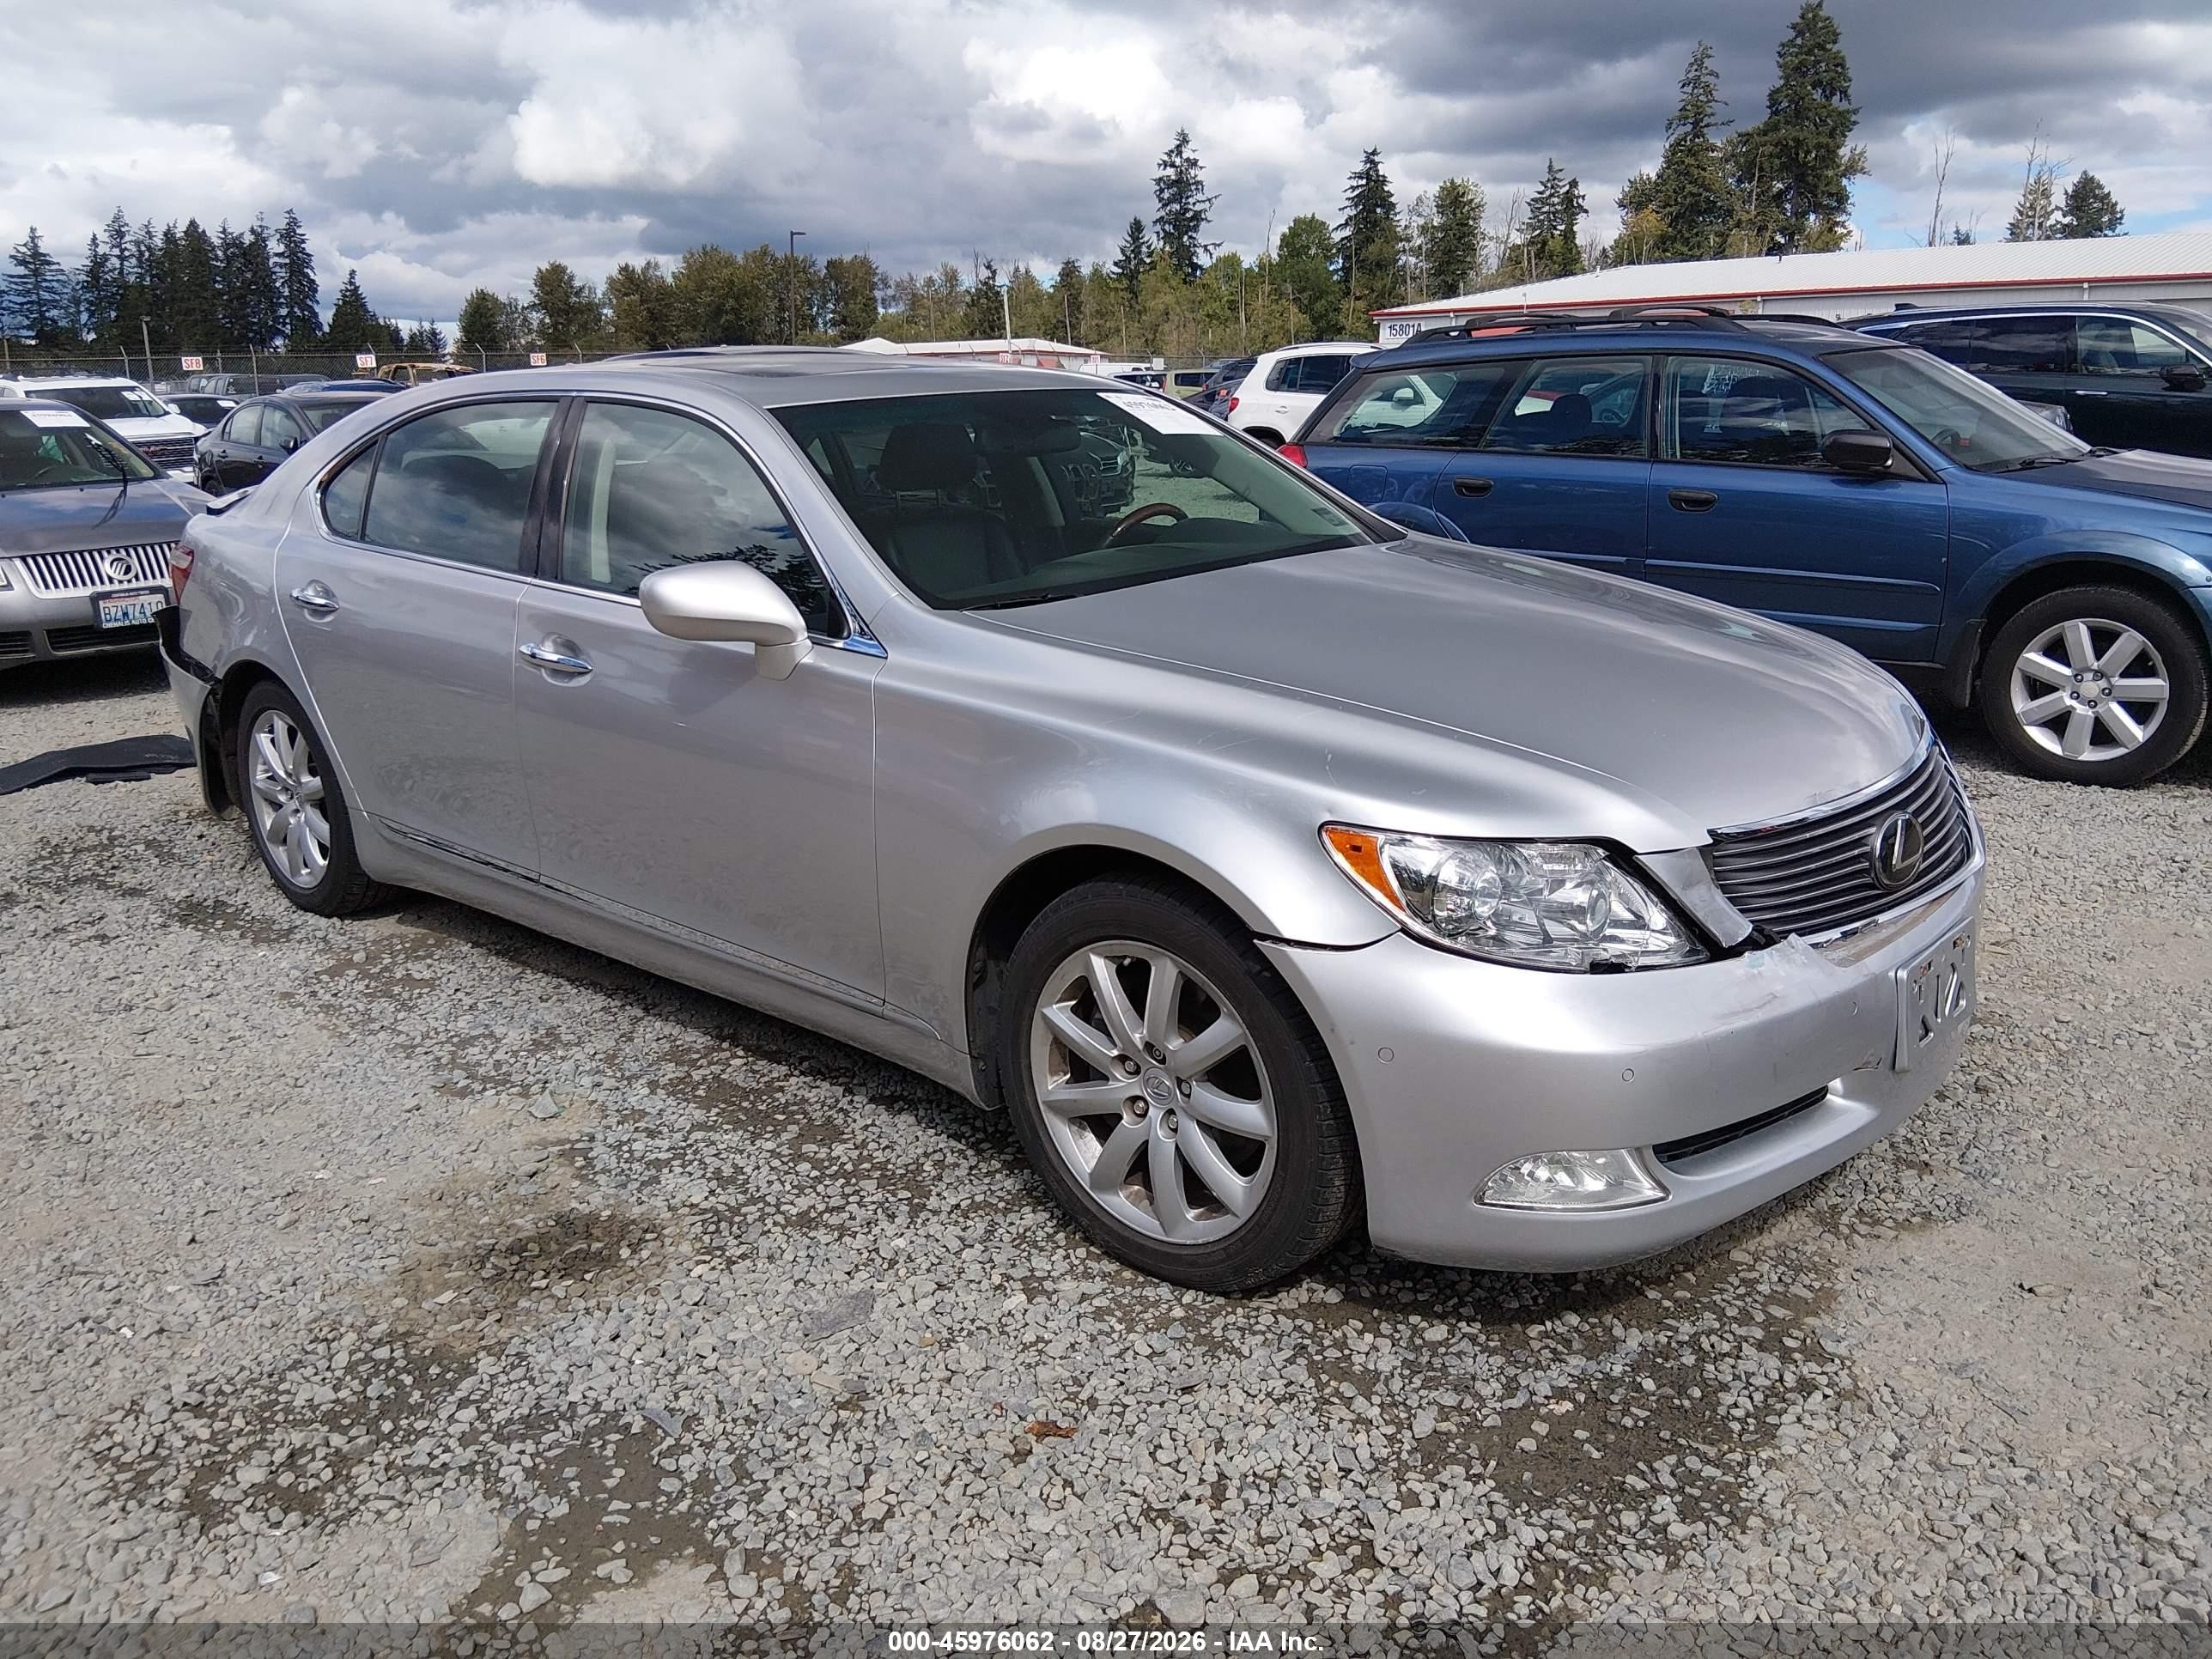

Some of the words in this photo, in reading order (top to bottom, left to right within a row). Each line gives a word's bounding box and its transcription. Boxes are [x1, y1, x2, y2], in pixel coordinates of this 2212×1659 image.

[1388, 322, 1422, 337] 15801A
[184, 358, 201, 369] SF8
[359, 356, 373, 367] SF7
[532, 355, 545, 365] SF6
